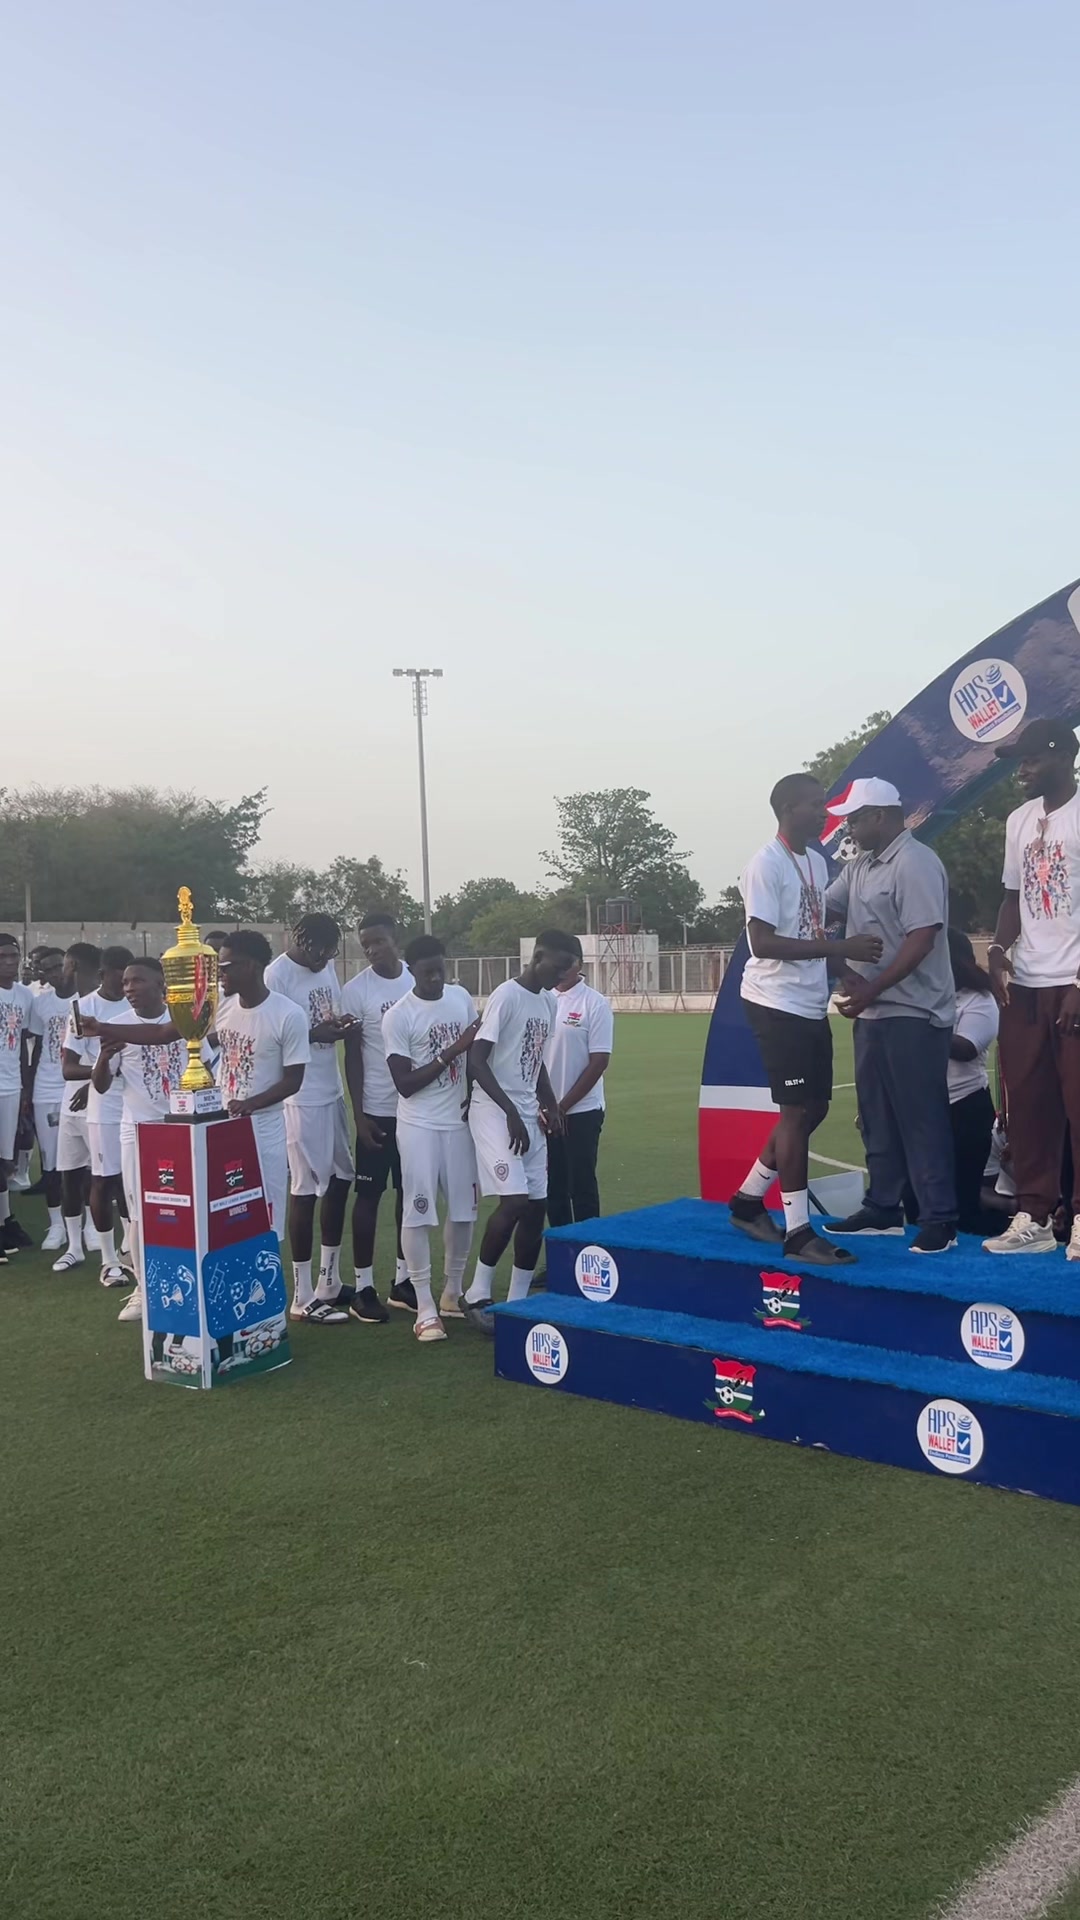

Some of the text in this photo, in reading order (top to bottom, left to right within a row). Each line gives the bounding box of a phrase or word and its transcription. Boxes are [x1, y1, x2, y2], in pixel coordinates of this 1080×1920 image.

[954, 675, 993, 716] APS
[968, 700, 1000, 730] WALLET
[581, 1253, 600, 1275] APS
[582, 1274, 600, 1286] WALLET
[971, 1310, 998, 1337] APS
[532, 1331, 551, 1355] APS
[971, 1335, 998, 1351] WALLET
[532, 1353, 551, 1366] WALLET
[928, 1407, 956, 1438] APS
[928, 1433, 956, 1452] WALLET
